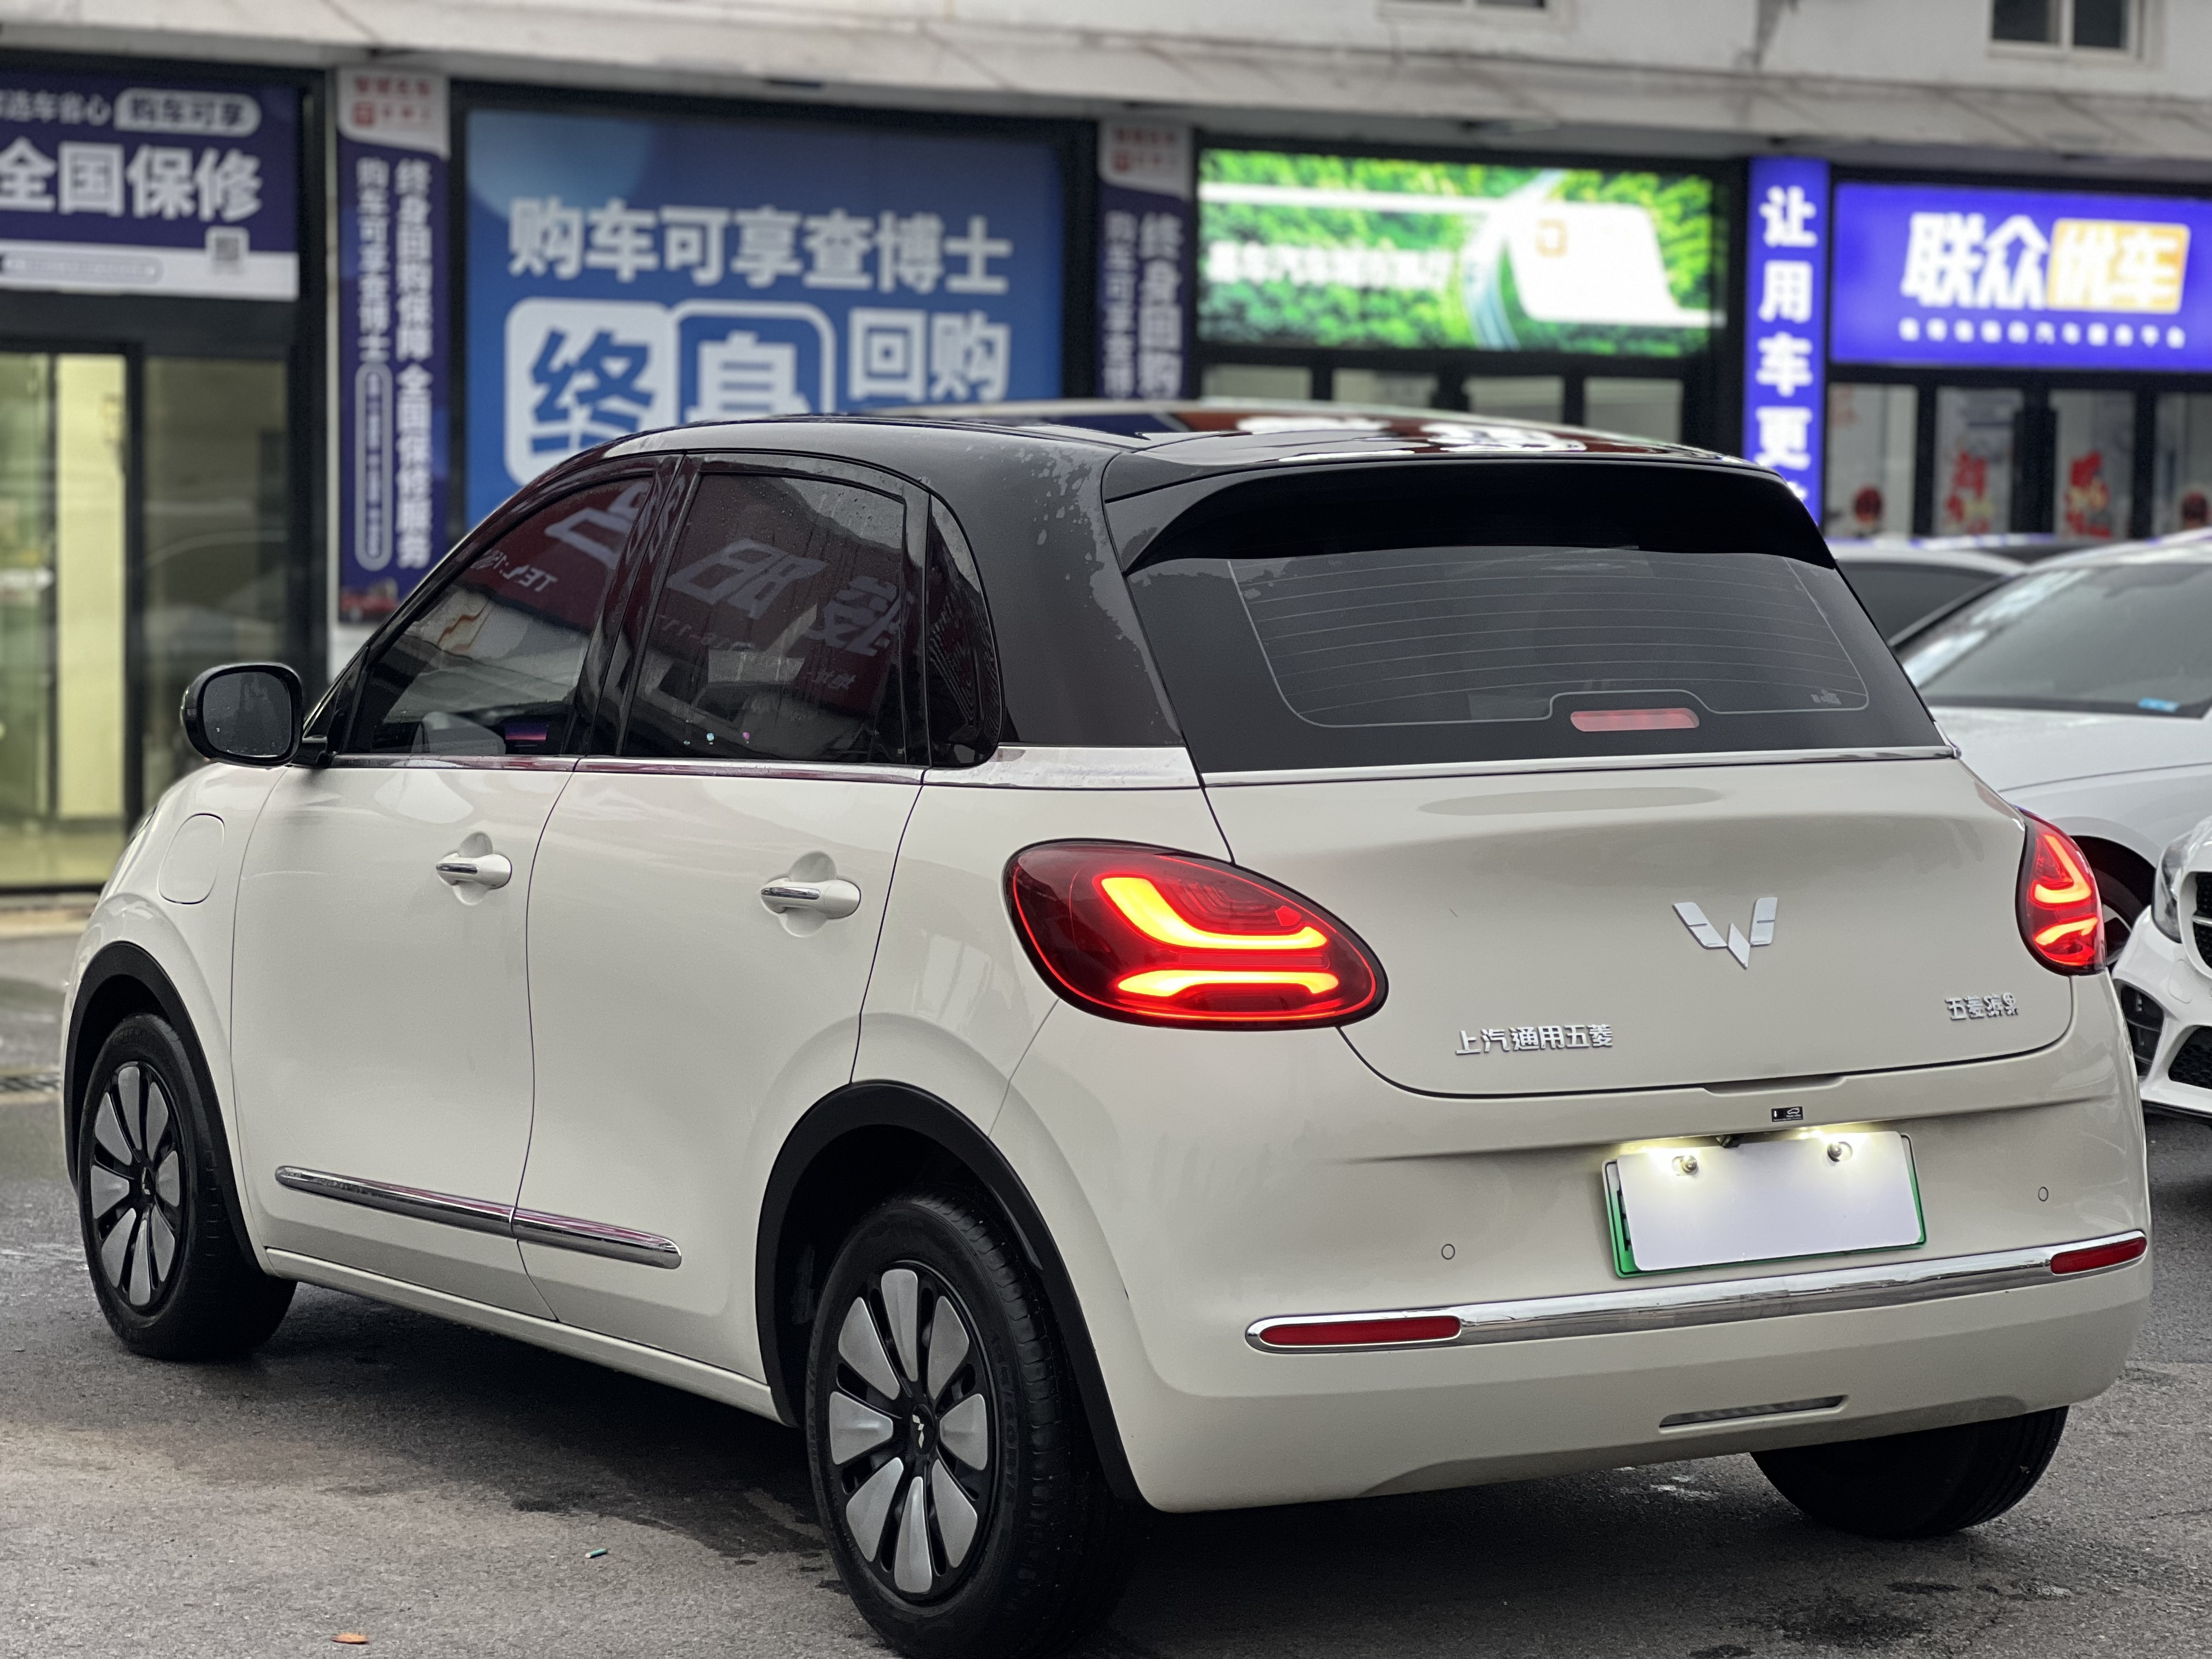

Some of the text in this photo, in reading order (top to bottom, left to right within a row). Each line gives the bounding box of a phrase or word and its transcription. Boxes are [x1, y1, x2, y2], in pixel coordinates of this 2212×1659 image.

[0, 89, 112, 126] 选车省心
[0, 136, 263, 222] 全国保修
[509, 198, 1012, 294] 购车可享查博士
[848, 308, 1011, 402] 回购
[1755, 185, 1817, 500] 让用车更
[1454, 1023, 1613, 1055] 上汽通用五菱
